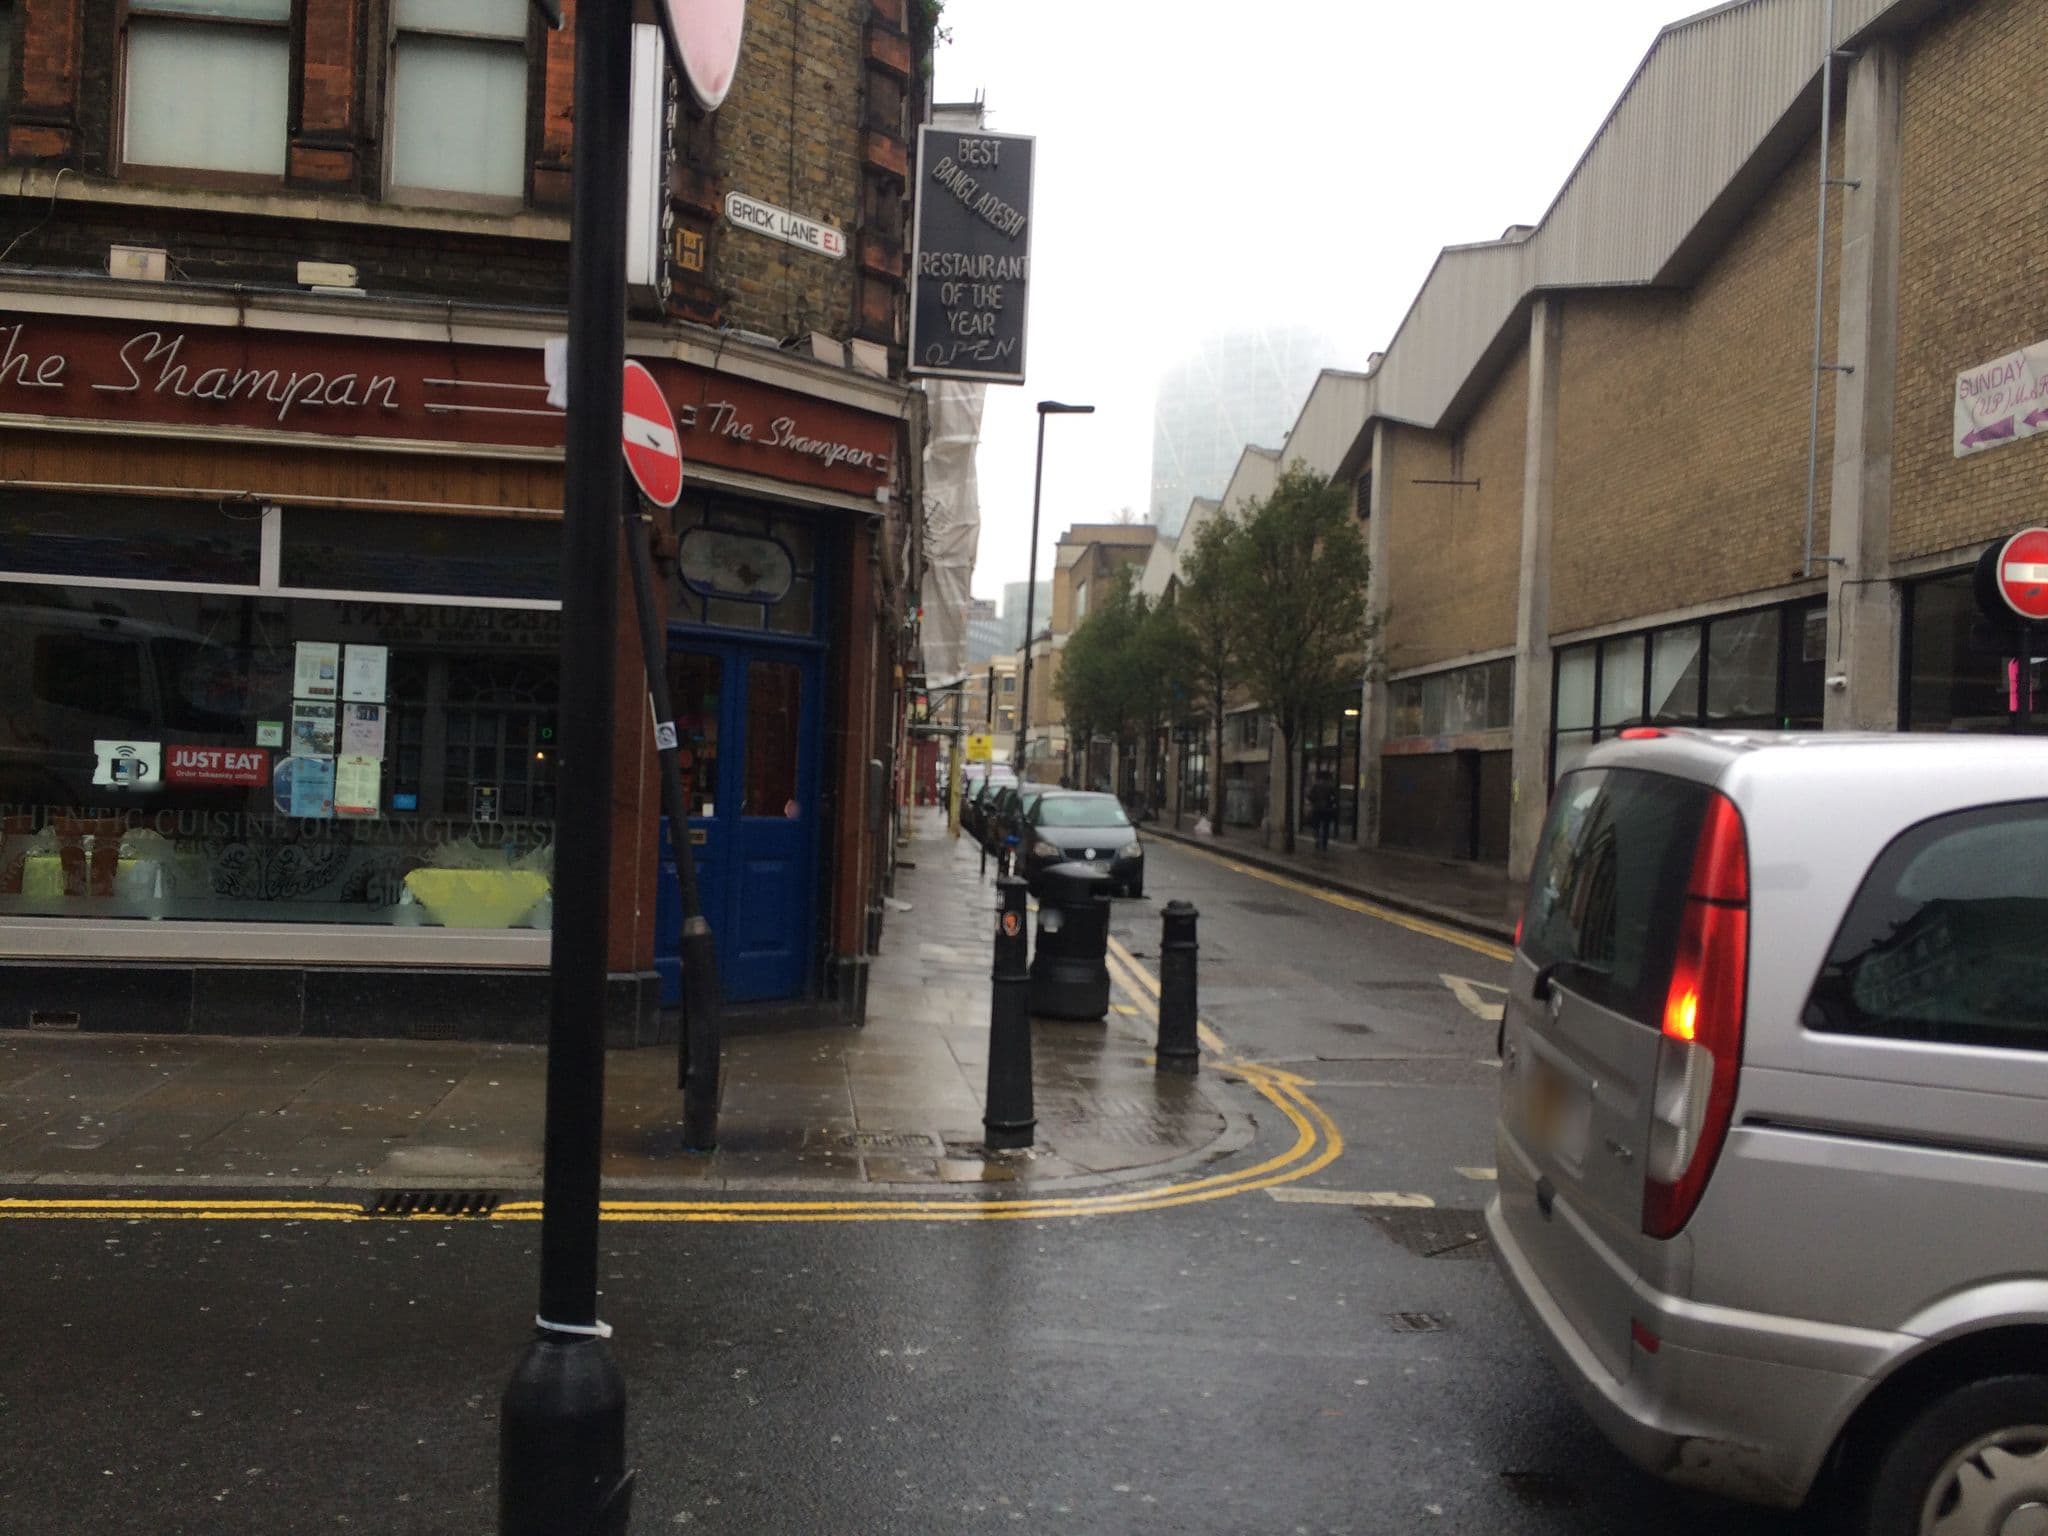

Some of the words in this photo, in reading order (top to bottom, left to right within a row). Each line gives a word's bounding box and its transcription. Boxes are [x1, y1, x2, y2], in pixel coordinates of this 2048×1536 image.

[958, 137, 1002, 166] BEST
[732, 199, 774, 230] BRICK
[780, 216, 818, 245] LANE
[919, 251, 1029, 281] RESTAURANT
[941, 282, 967, 306] OF
[971, 284, 1003, 310] THE
[947, 311, 996, 337] YEAR
[92, 331, 399, 421] Shampan
[1959, 359, 2025, 400] SUNDAY
[707, 400, 754, 441] The
[758, 416, 873, 468] Shampan
[172, 750, 221, 769] JUST
[224, 753, 263, 770] EAT
[155, 808, 288, 838] CUISINE
